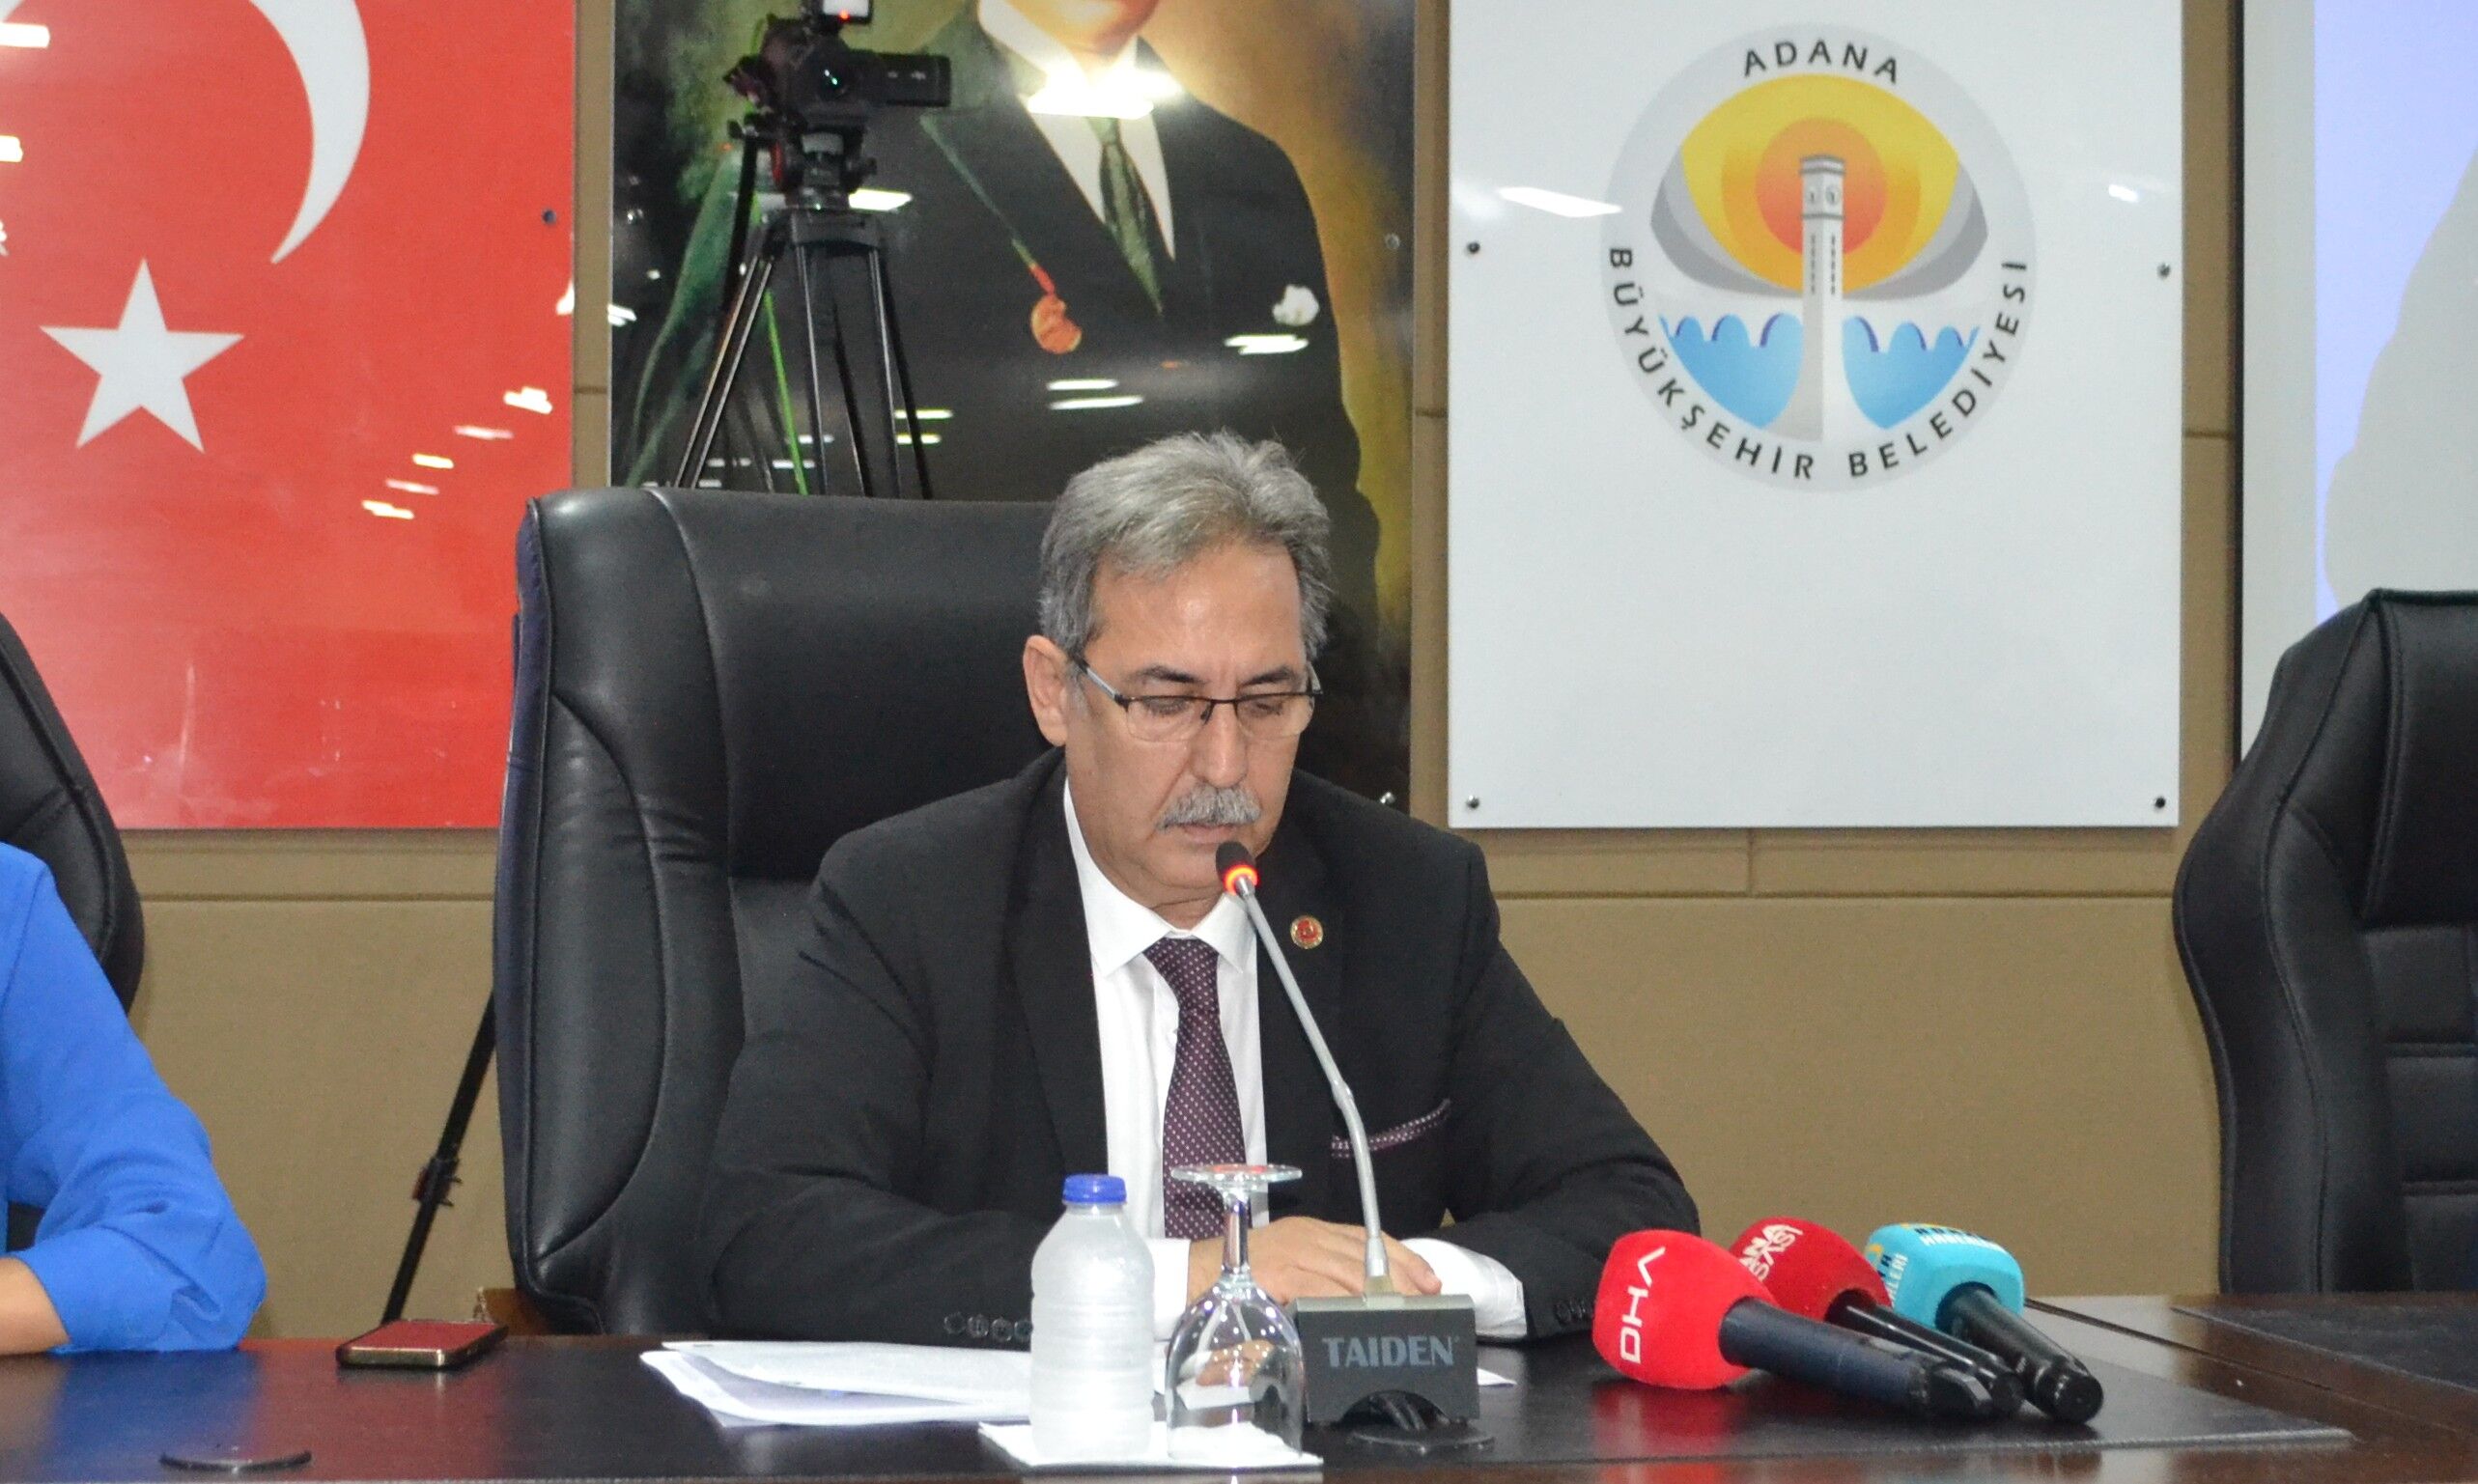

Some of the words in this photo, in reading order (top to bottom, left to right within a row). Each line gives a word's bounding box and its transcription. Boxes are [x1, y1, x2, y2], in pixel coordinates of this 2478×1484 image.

[1744, 38, 1898, 85] ADANA
[1609, 246, 1815, 480] BÜYÜKŞEHİR
[1619, 1246, 1667, 1364] DHA
[1321, 1334, 1454, 1368] TAIDEN
